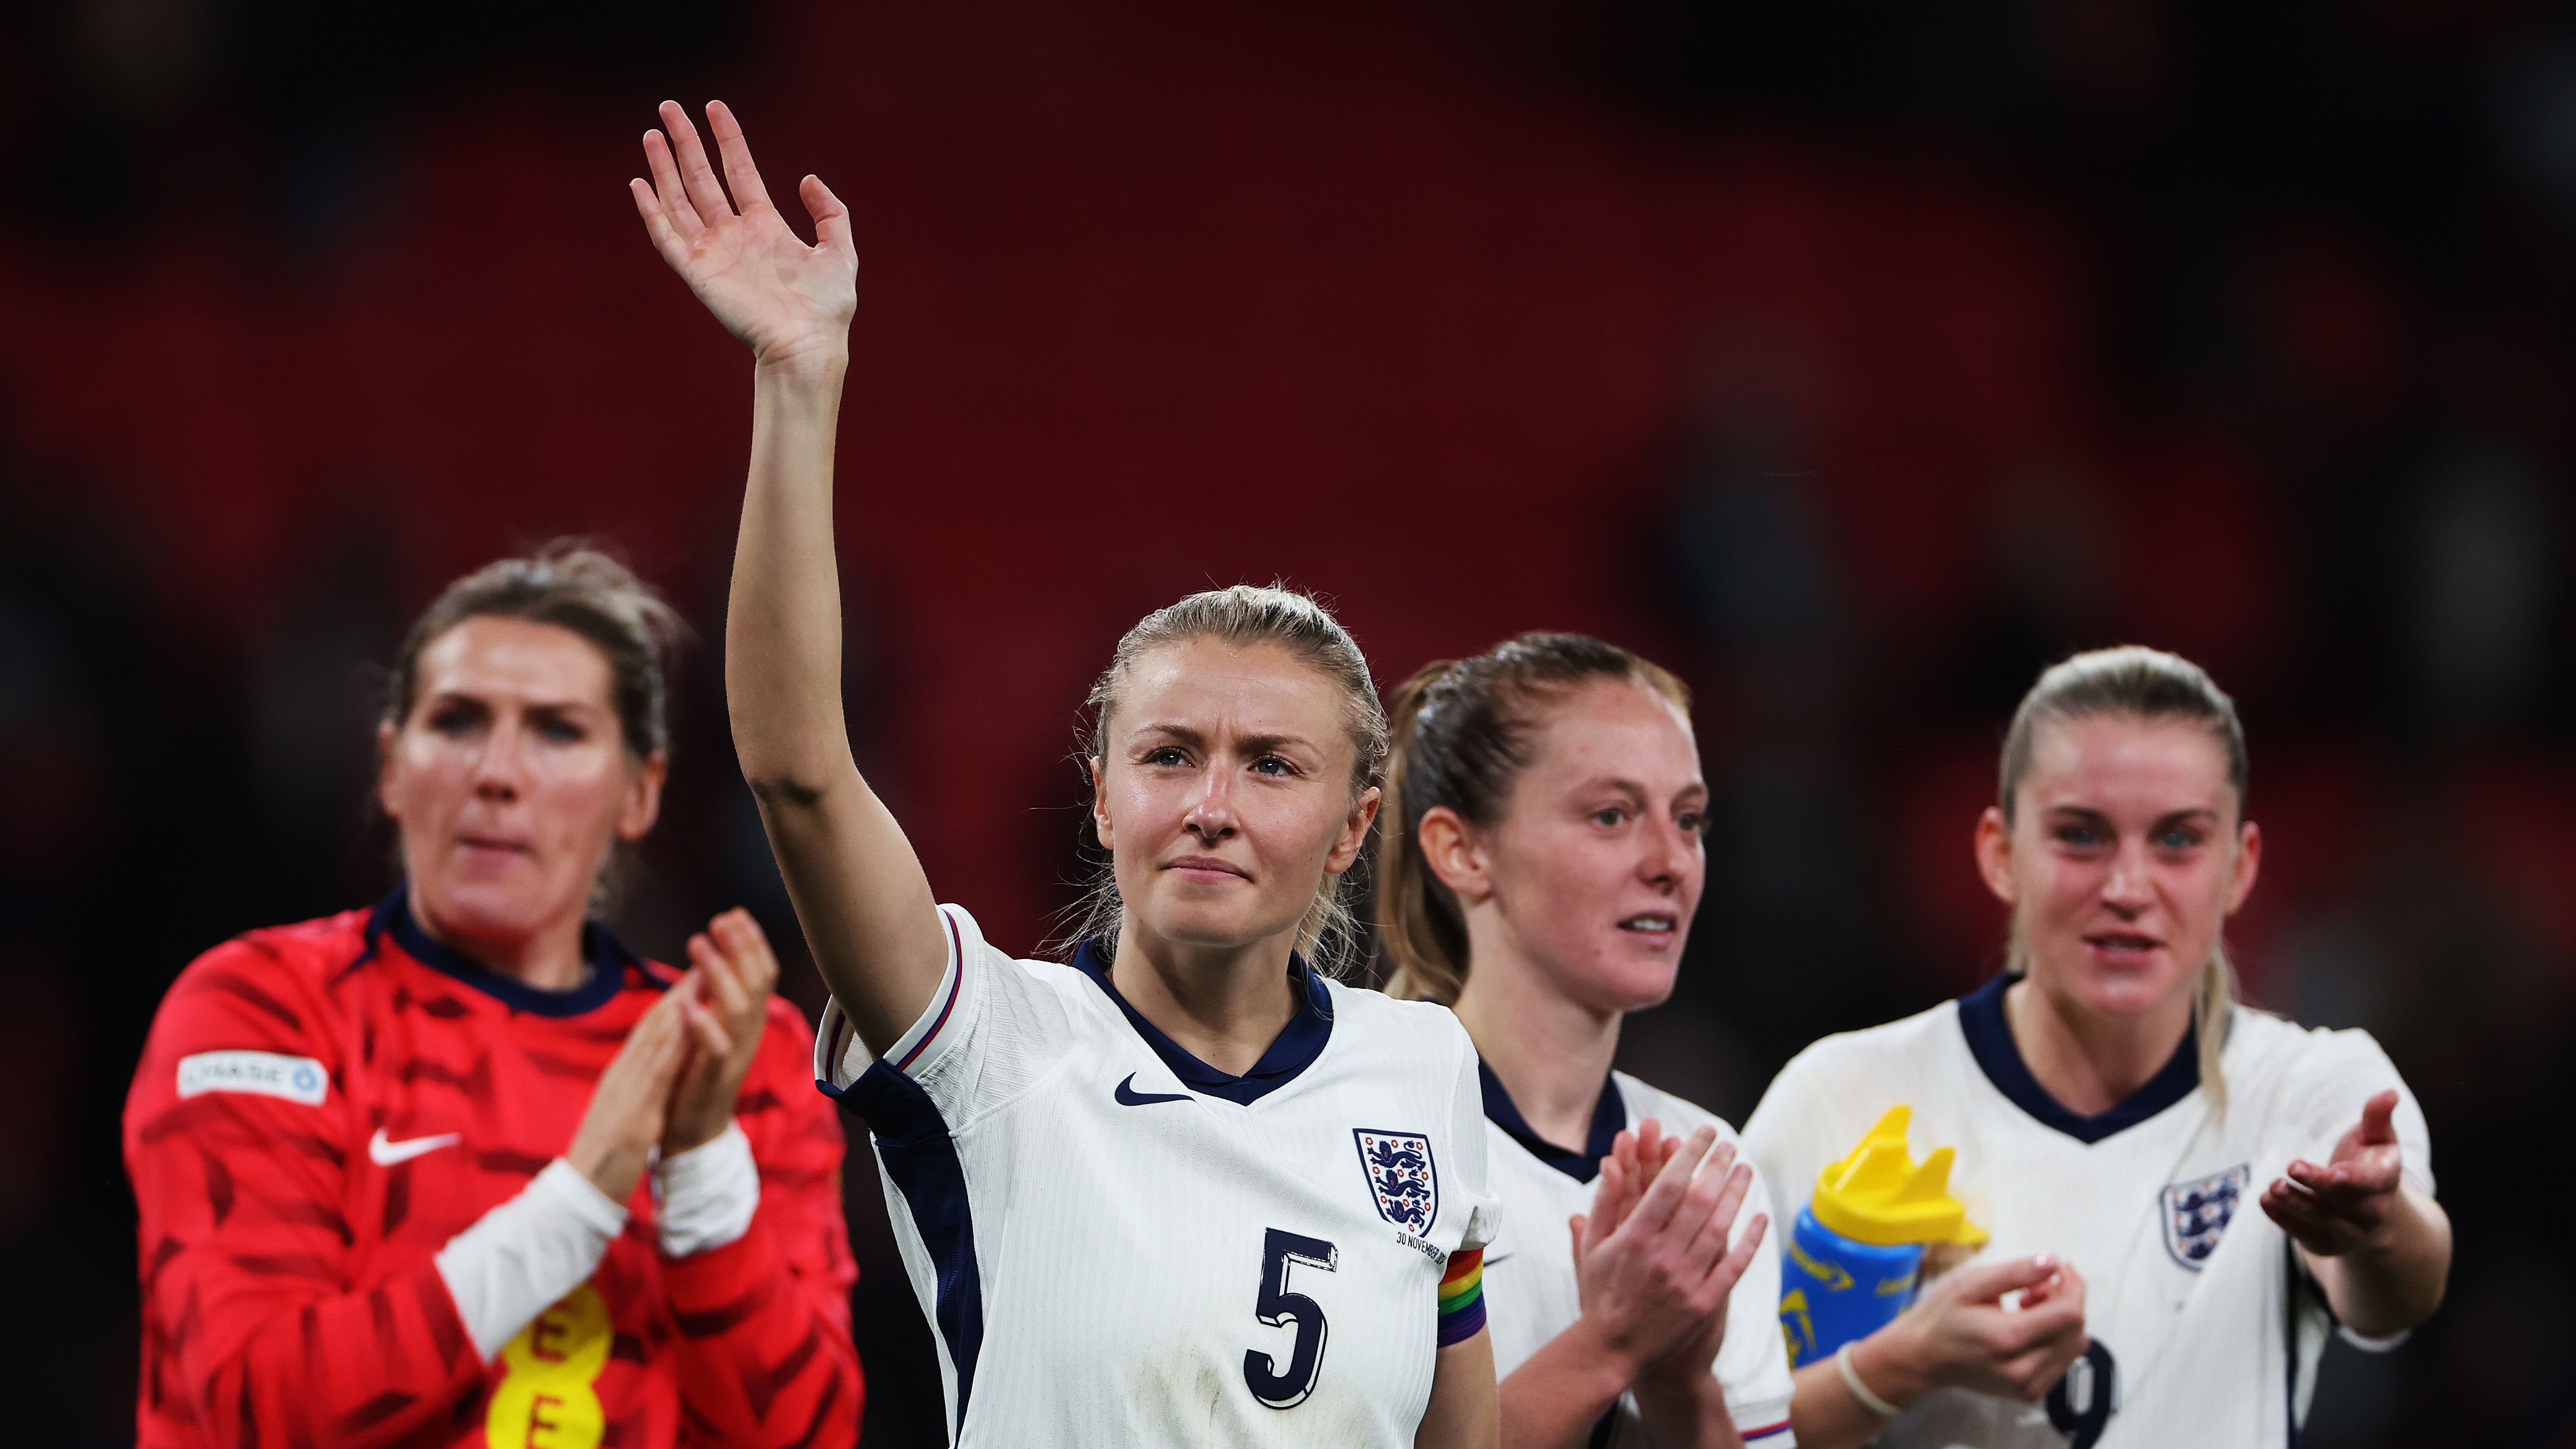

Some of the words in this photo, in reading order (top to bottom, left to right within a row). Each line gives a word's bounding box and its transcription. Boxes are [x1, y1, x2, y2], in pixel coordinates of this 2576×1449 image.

[1397, 1231, 1406, 1245] 30
[1408, 1235, 1440, 1260] NOVEMBER
[1244, 1227, 1338, 1410] 5
